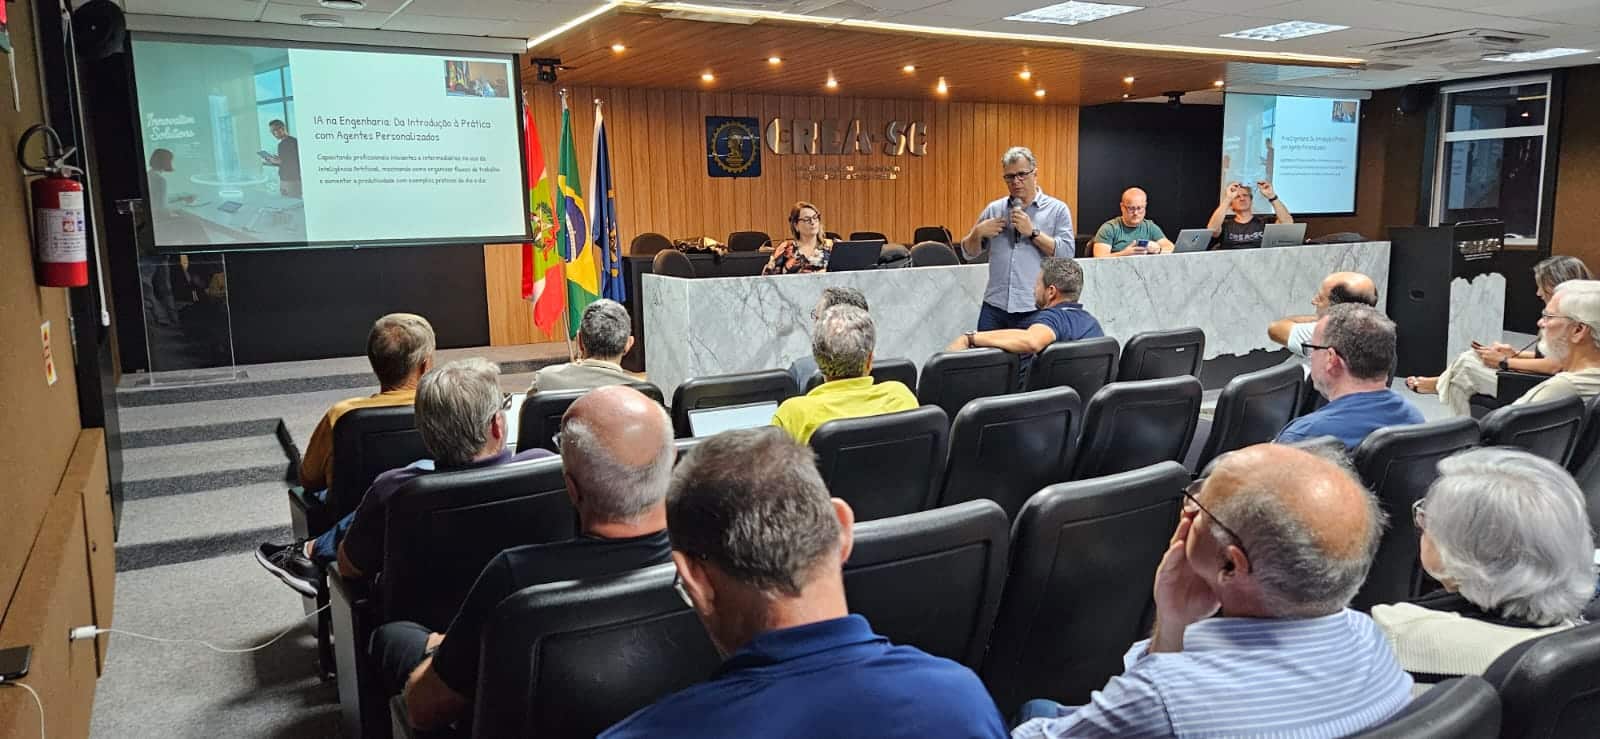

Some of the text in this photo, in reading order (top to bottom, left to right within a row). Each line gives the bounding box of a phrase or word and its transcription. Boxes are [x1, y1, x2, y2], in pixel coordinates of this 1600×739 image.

[313, 115, 323, 125] IA
[326, 118, 337, 126] na
[339, 115, 391, 130] Engenharia:
[394, 117, 406, 127] Da
[407, 117, 452, 130] Introdução
[461, 117, 491, 129] Prática
[151, 127, 195, 141] Solutions
[314, 130, 440, 144] com Agentes Personalizados
